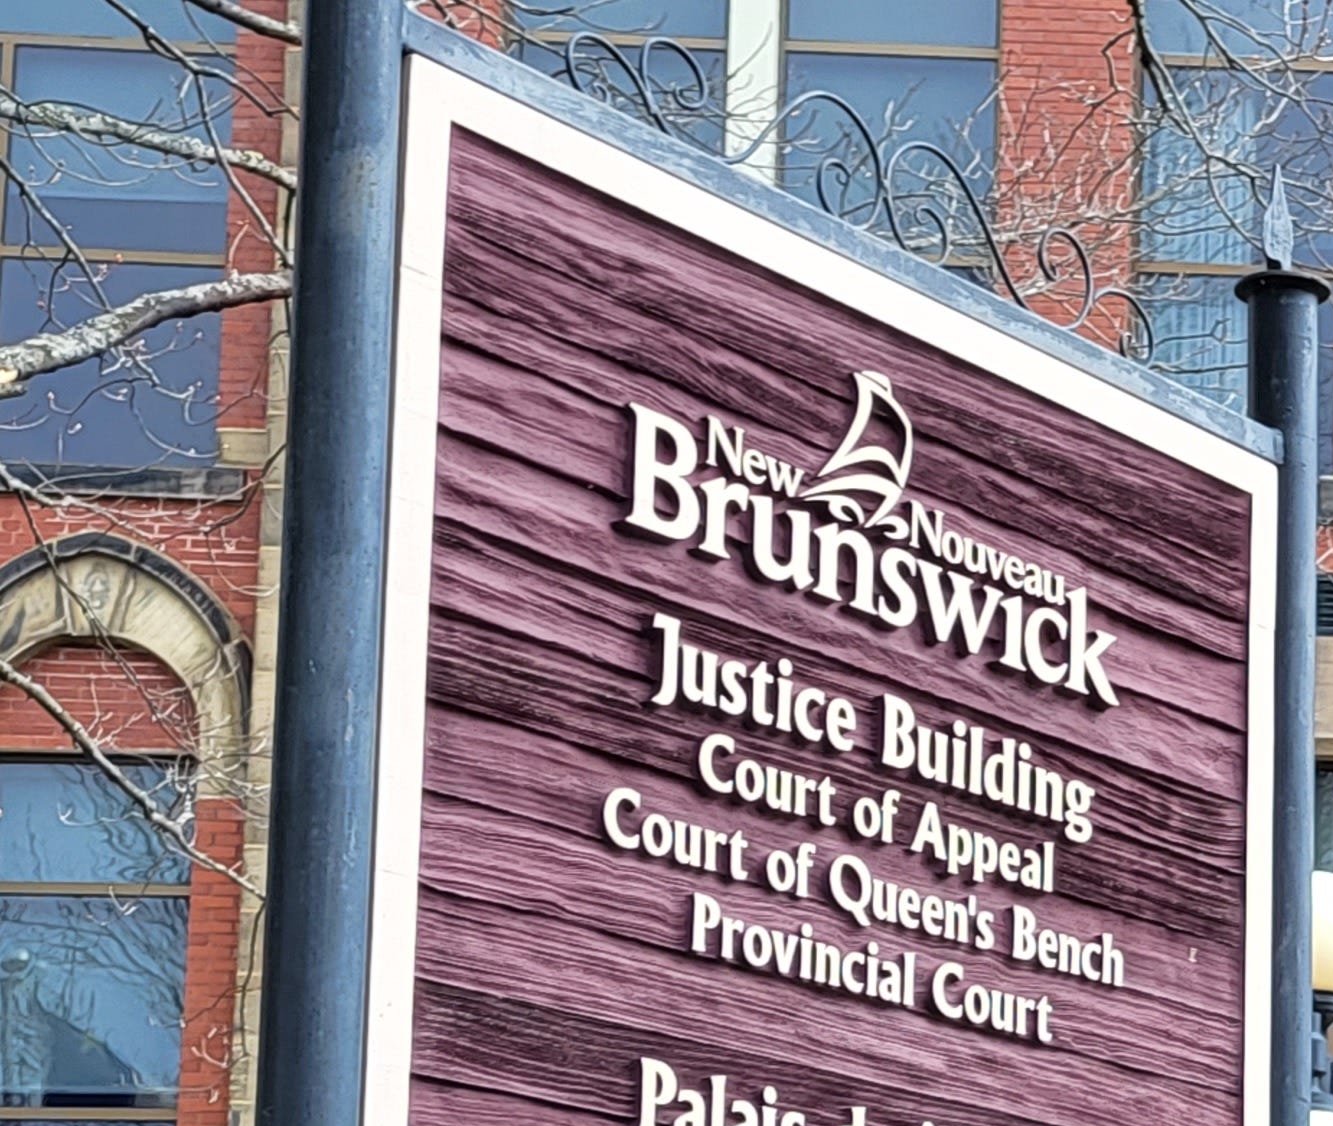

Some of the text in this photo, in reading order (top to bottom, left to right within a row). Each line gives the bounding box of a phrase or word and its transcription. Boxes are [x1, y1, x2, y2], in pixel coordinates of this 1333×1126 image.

[705, 414, 804, 498] New
[624, 401, 1120, 706] Brunswick
[908, 501, 1066, 604] Nouveau
[651, 612, 1095, 843] Justice Building
[603, 787, 1125, 987] Court of Queen's Bench
[698, 734, 1055, 892] Court of Appeal
[691, 892, 1053, 1043] Provincial Court
